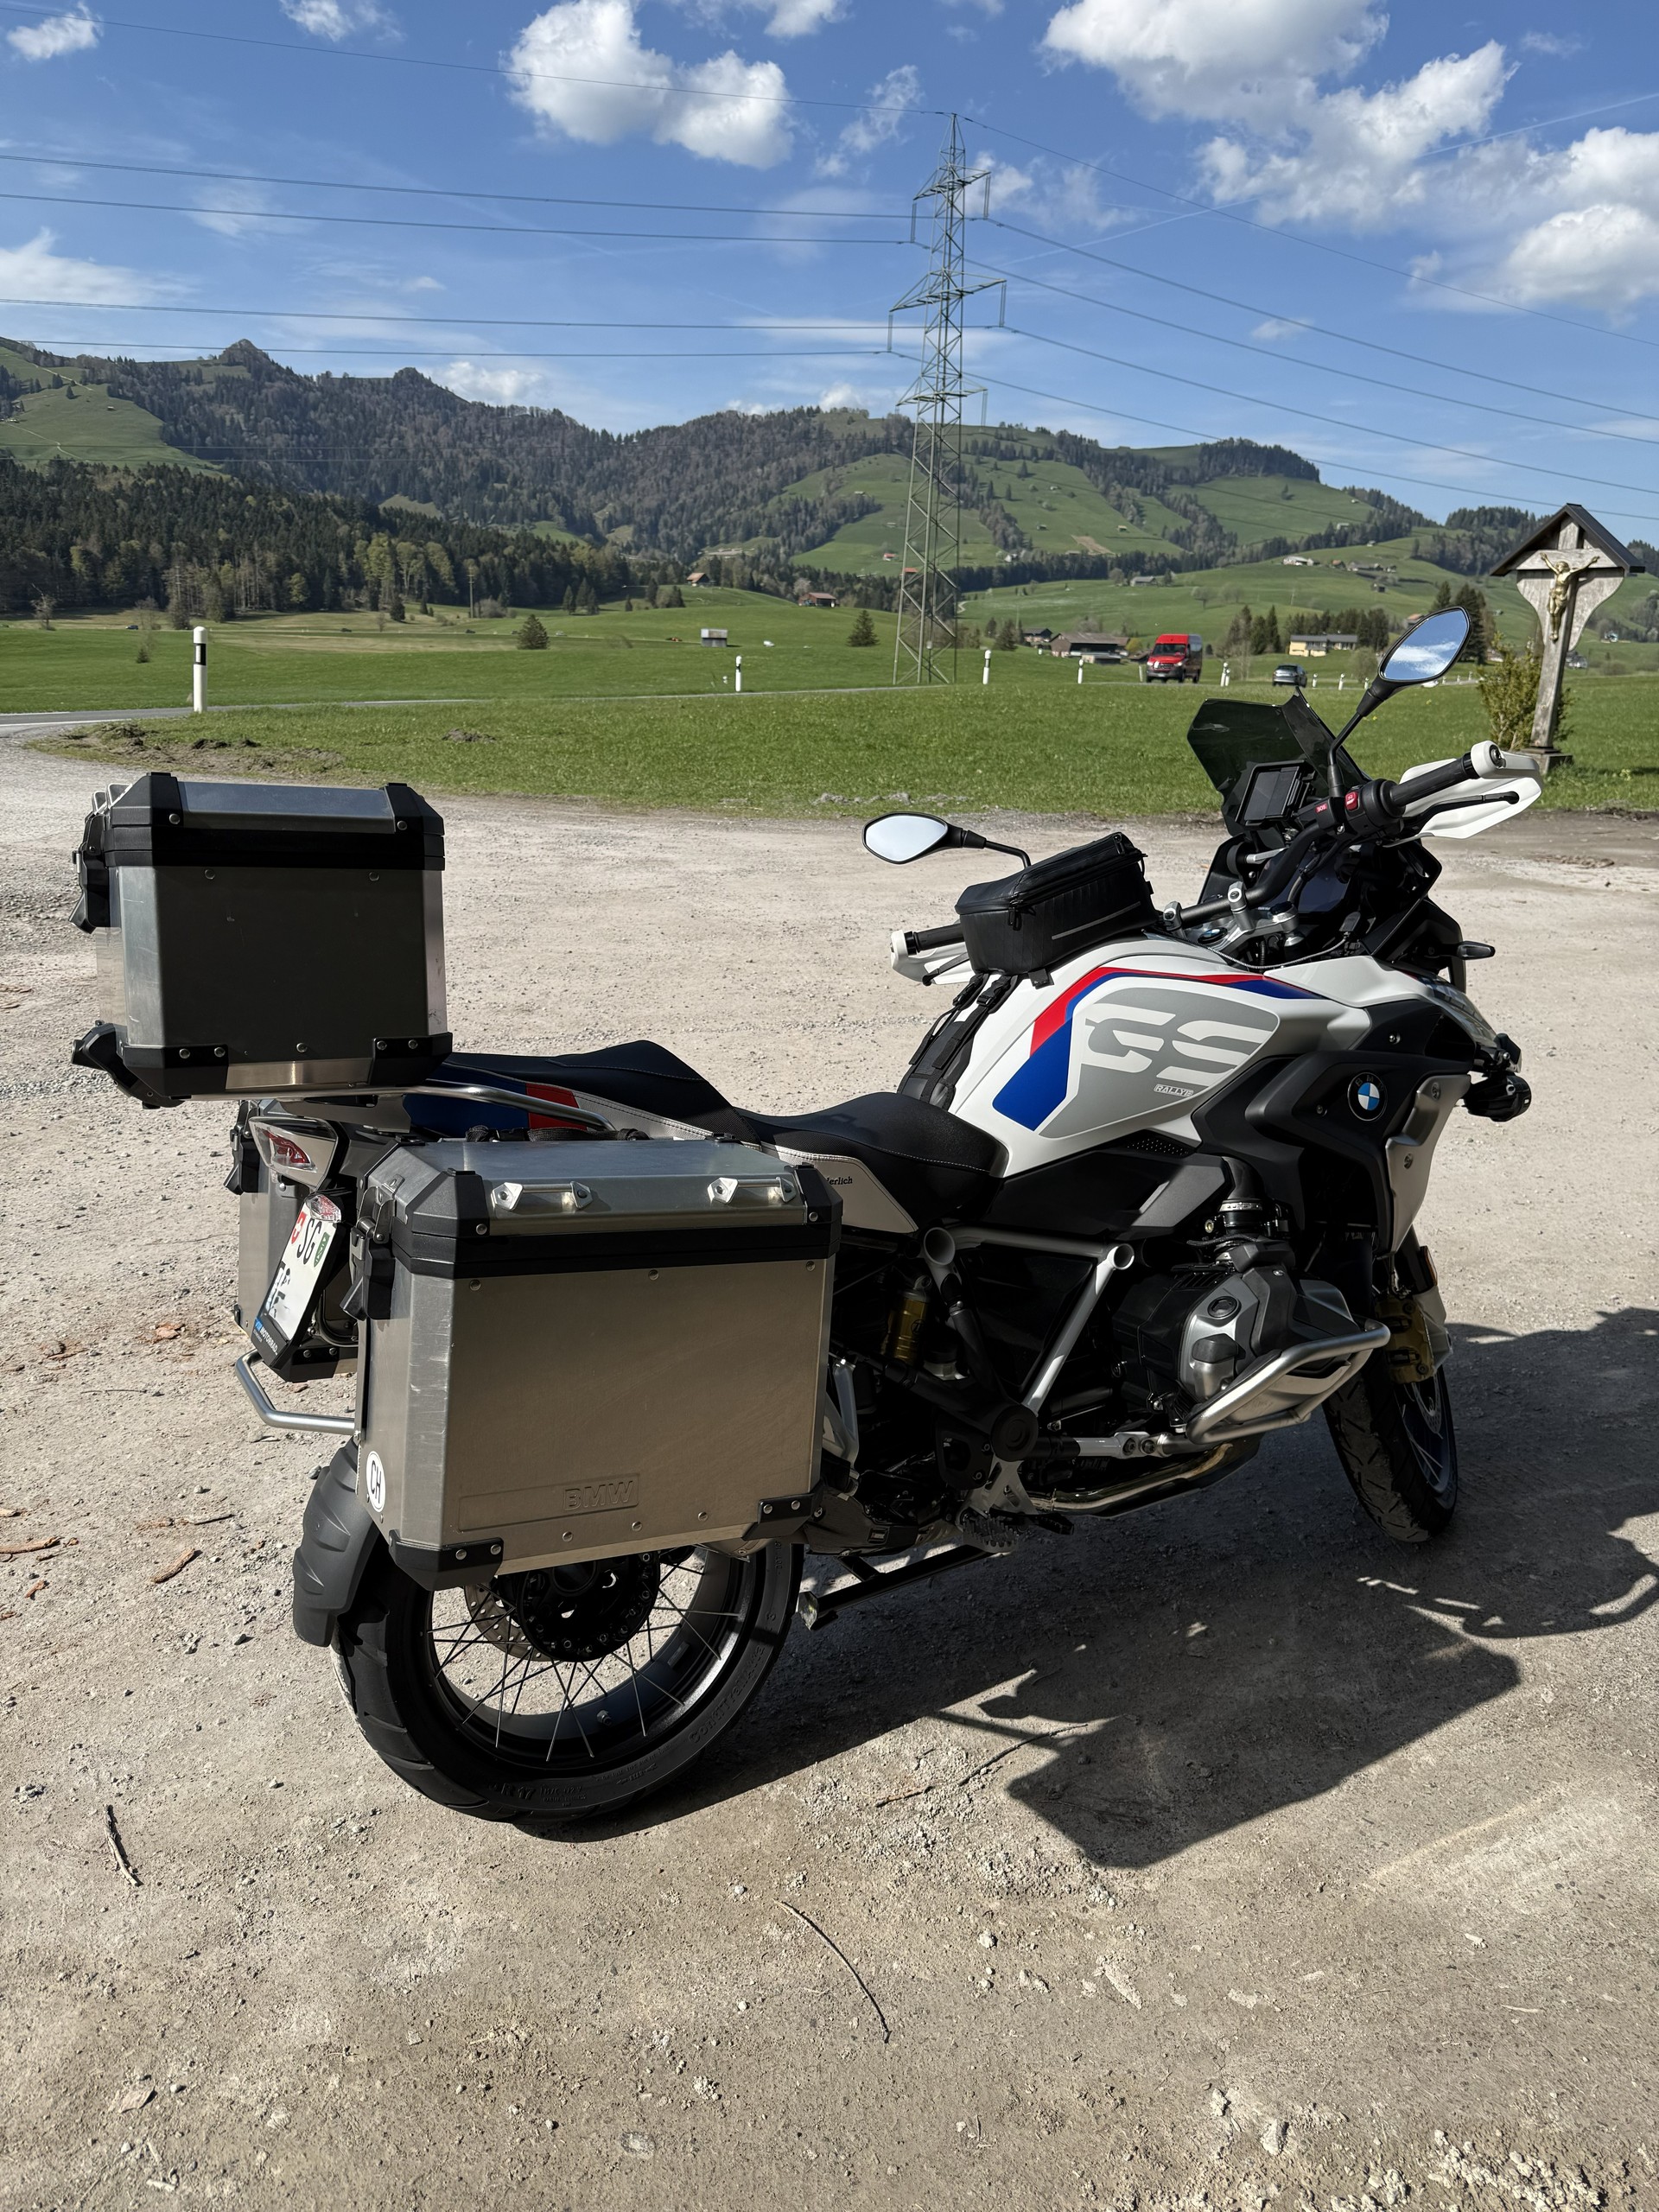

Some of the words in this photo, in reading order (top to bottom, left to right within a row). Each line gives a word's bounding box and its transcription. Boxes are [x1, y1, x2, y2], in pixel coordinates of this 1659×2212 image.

[1082, 1003, 1274, 1087] GS
[1154, 1084, 1193, 1097] RALLYE
[297, 1217, 322, 1265] SG
[371, 1460, 382, 1503] CH
[563, 1480, 634, 1510] BMW
